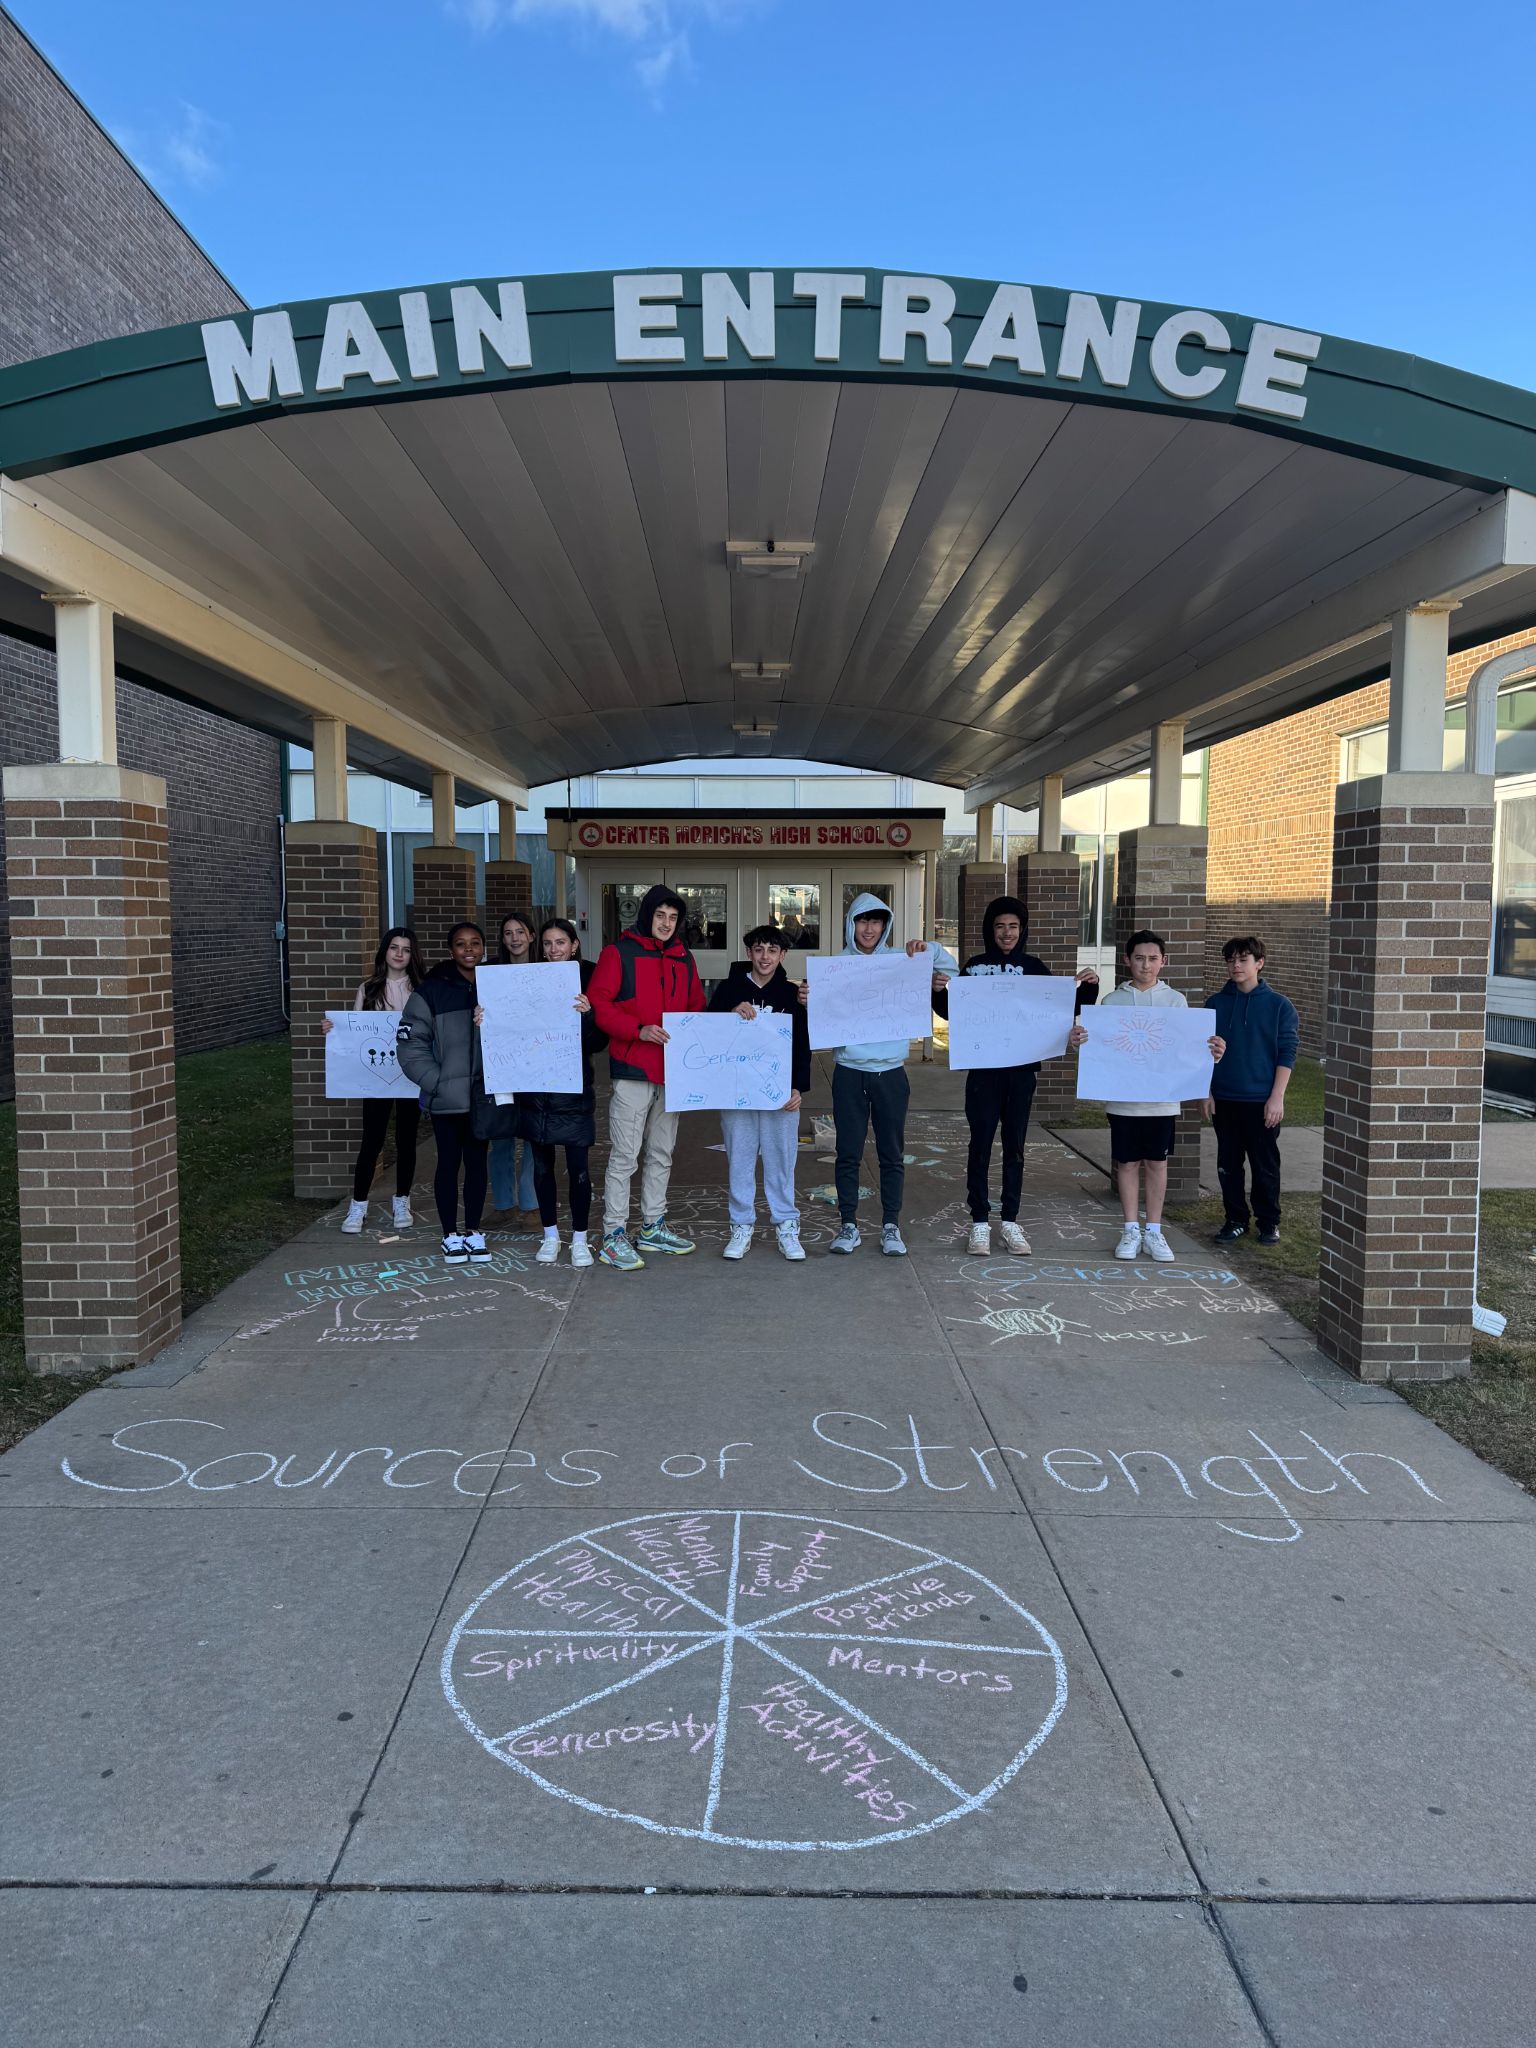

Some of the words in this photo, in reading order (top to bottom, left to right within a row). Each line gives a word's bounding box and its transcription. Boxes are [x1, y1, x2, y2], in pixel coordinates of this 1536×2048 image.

[201, 281, 532, 410] MAIN
[613, 272, 1322, 420] ENTRANCE
[605, 825, 670, 845] CENTER
[675, 825, 764, 845] MORICHES
[769, 825, 811, 845] HIGH
[816, 825, 885, 845] SCHOOL
[347, 1012, 380, 1036] Family
[284, 1247, 538, 1286] MENL
[297, 1258, 529, 1303] HEALTH
[61, 1418, 620, 1497] Sources
[660, 1441, 754, 1479] of
[793, 1410, 1445, 1543] Strength
[624, 1527, 696, 1593] Health
[664, 1516, 727, 1578] Mental
[739, 1540, 793, 1598] Family
[774, 1528, 841, 1593] Support
[512, 1572, 639, 1632] Health
[555, 1548, 686, 1622] Physical
[812, 1576, 947, 1627] Positive
[463, 1639, 679, 1681] Spirituality
[827, 1646, 1014, 1692] Mentors
[508, 1707, 718, 1757] Generosity
[762, 1680, 894, 1769] Healthy
[739, 1702, 917, 1822] Activities
